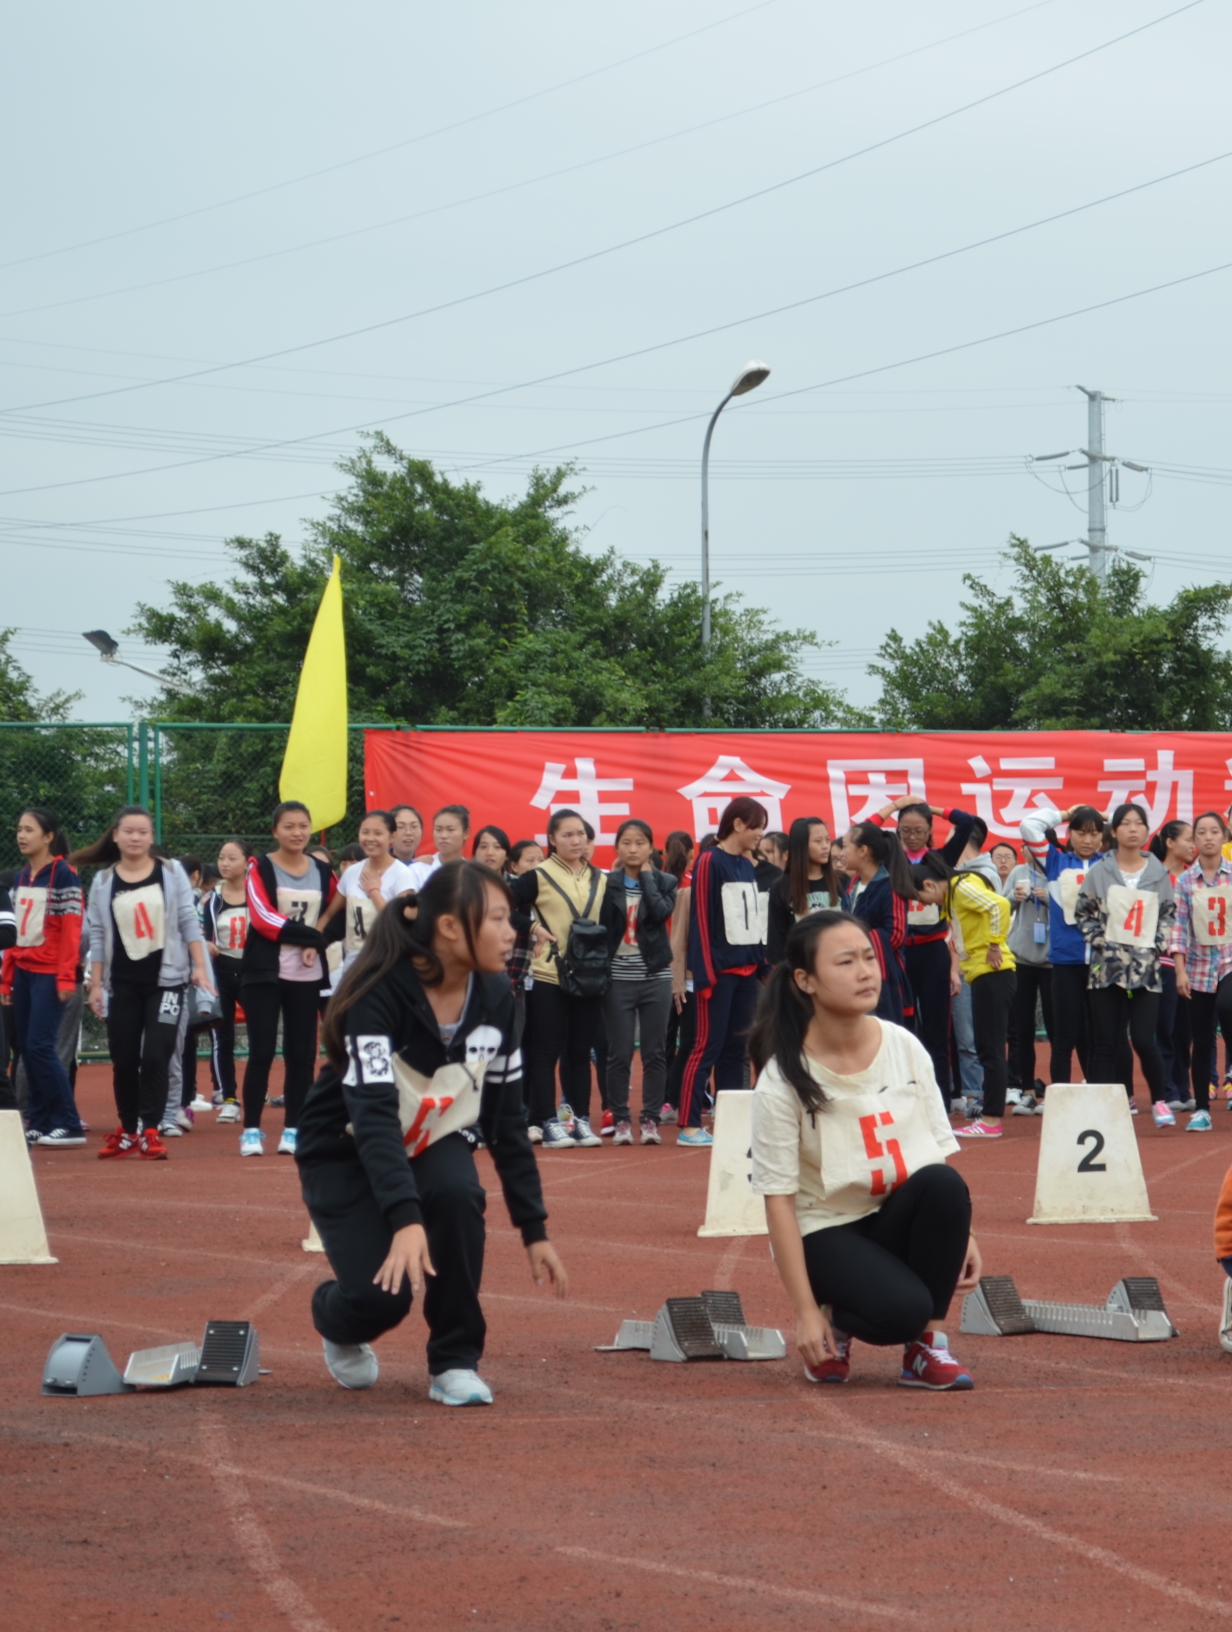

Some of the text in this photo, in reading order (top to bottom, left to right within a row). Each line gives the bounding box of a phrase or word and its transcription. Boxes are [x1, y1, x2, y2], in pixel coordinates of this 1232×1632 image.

[20, 899, 33, 936] 7
[134, 902, 154, 940] 4
[229, 916, 247, 949] 8
[1124, 900, 1144, 937] 4
[1208, 897, 1226, 936] 3
[858, 1111, 908, 1196] 5
[1077, 1129, 1106, 1173] 2
